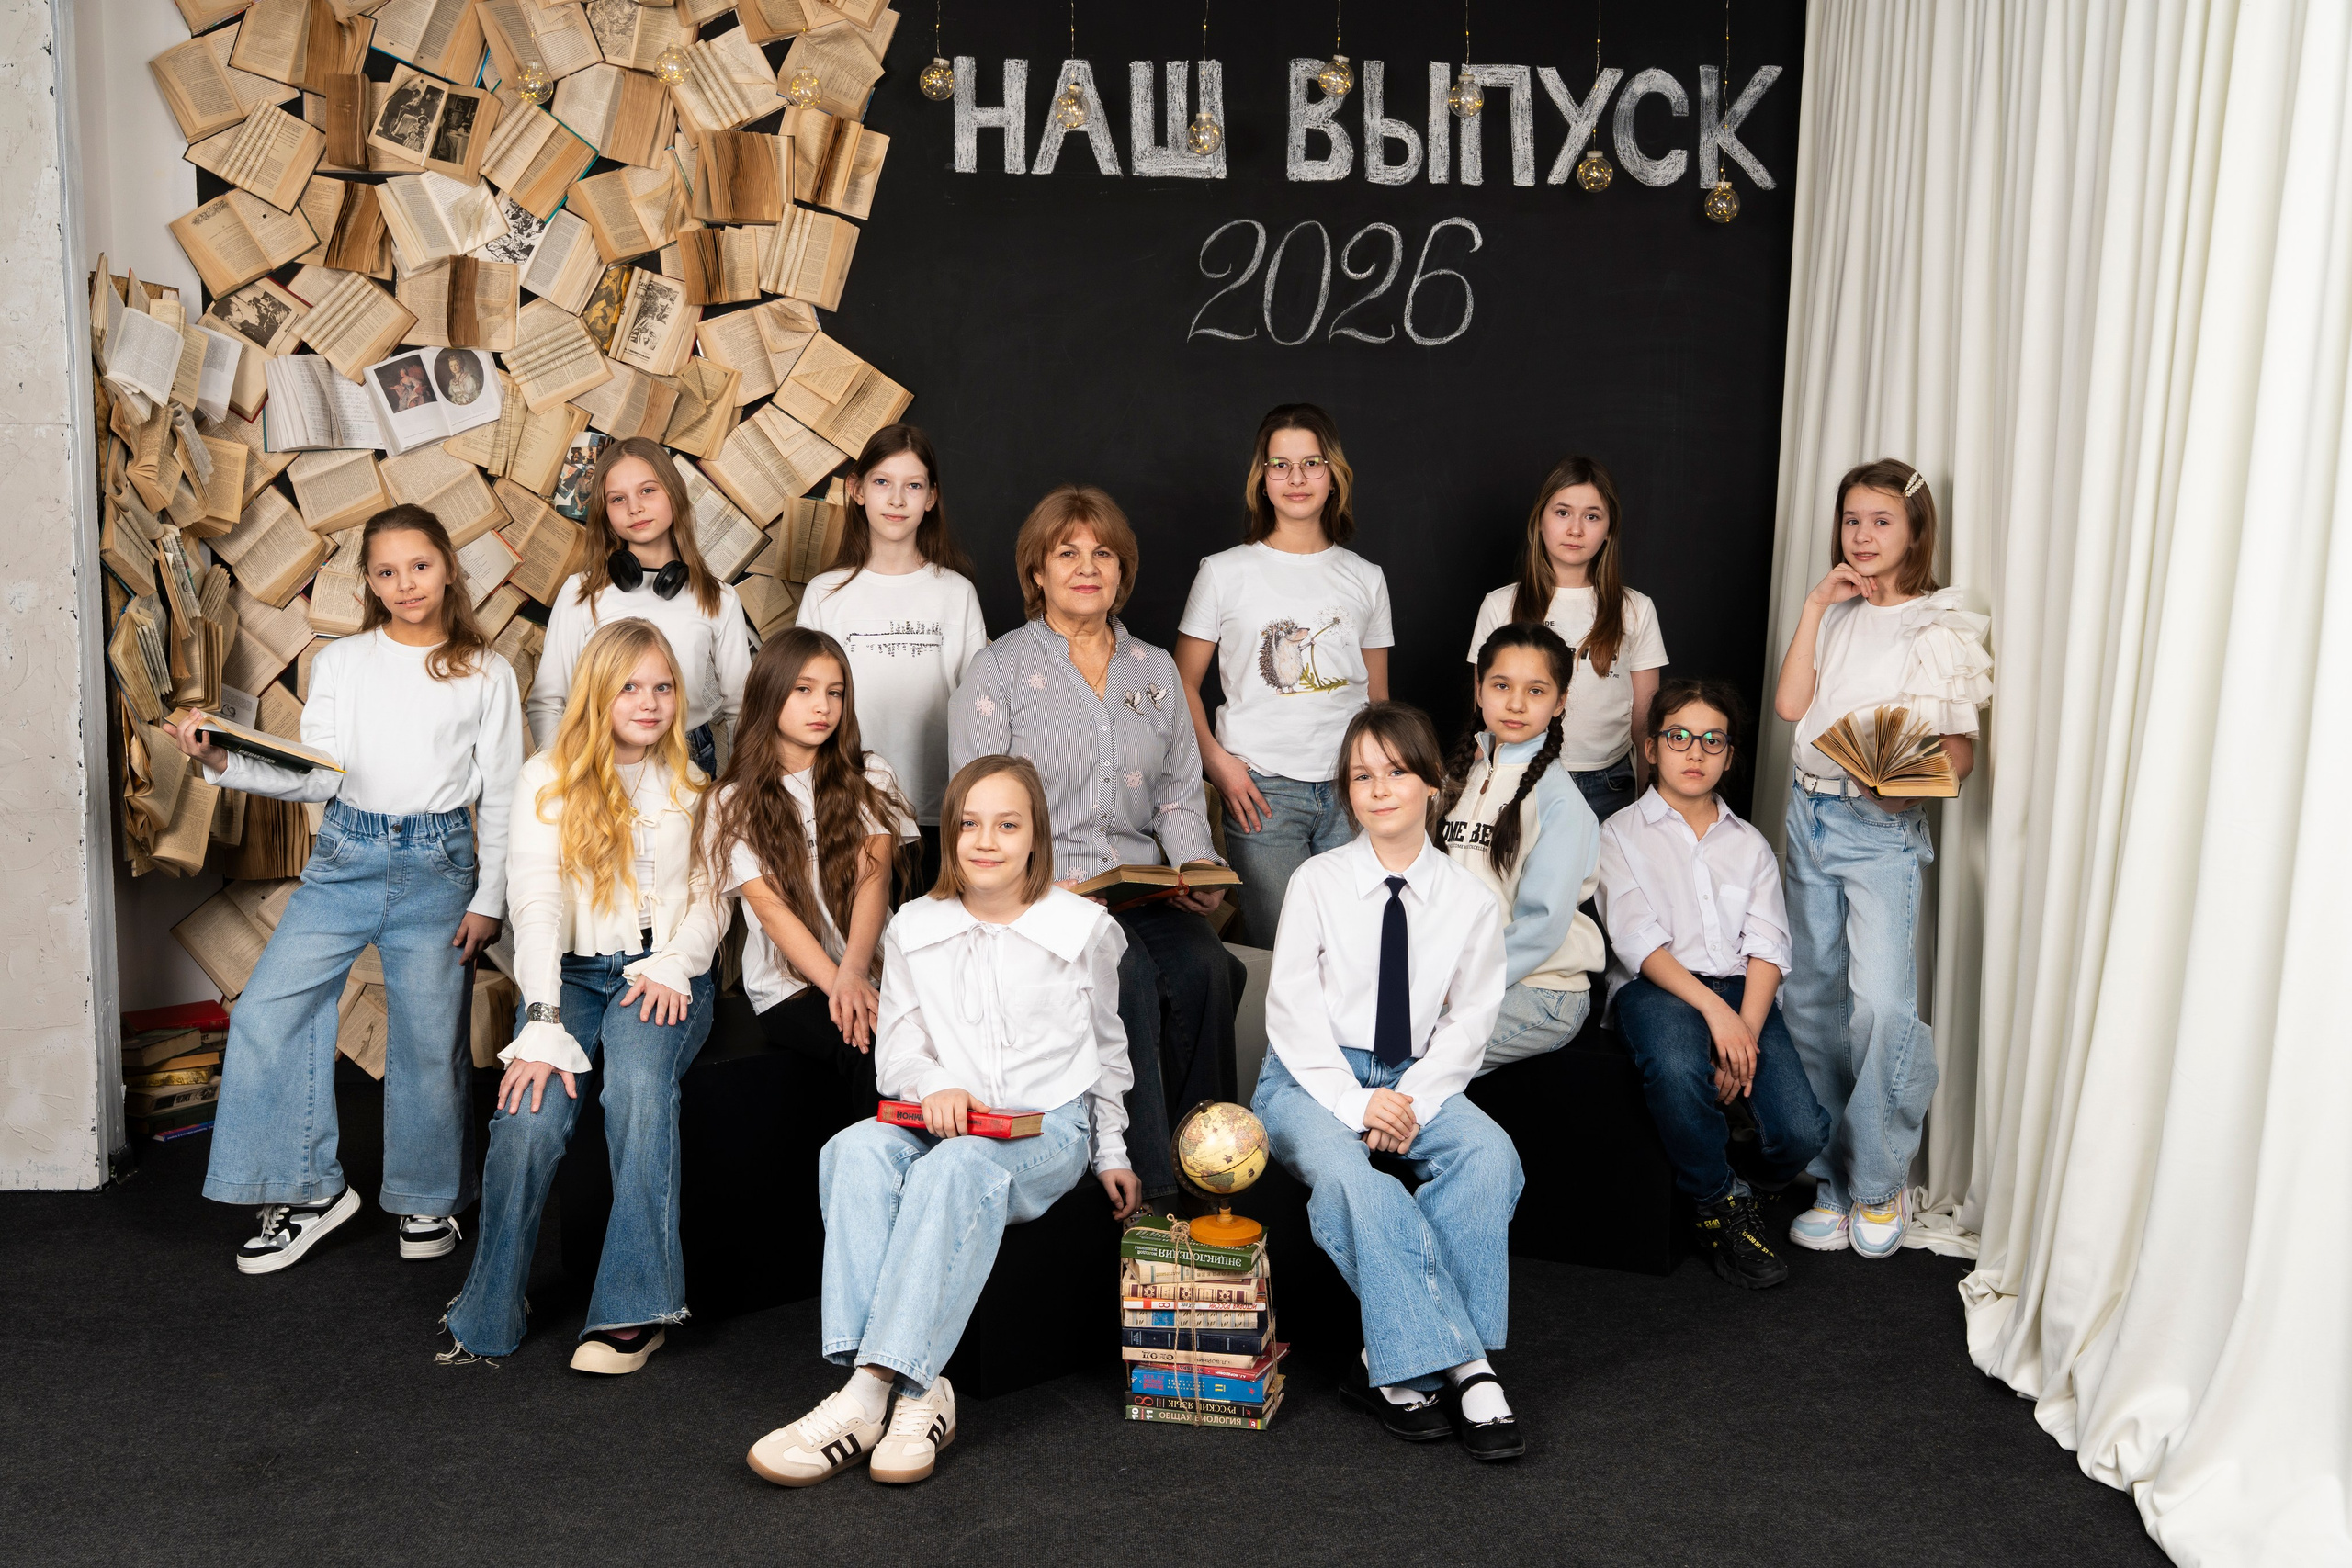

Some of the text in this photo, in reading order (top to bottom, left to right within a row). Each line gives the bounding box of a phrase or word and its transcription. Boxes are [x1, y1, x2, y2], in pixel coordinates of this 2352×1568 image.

[953, 56, 1783, 191] НАШ ВЫПУСК
[1187, 216, 1483, 346] 2026
[238, 750, 277, 763] РЕВИЗИЯ
[1159, 1248, 1242, 1267] ЭНЦИКЛОПЕДИЯ
[1179, 1364, 1204, 1373] АЛЕБРА
[1134, 1395, 1154, 1406] 8
[1168, 1399, 1193, 1411] ЯЗЫК
[1131, 1407, 1139, 1420] 10
[1146, 1409, 1154, 1420] 11
[1159, 1411, 1193, 1422] ОБЩАЯ
[1194, 1414, 1242, 1426] БИОЛОГИЯ
